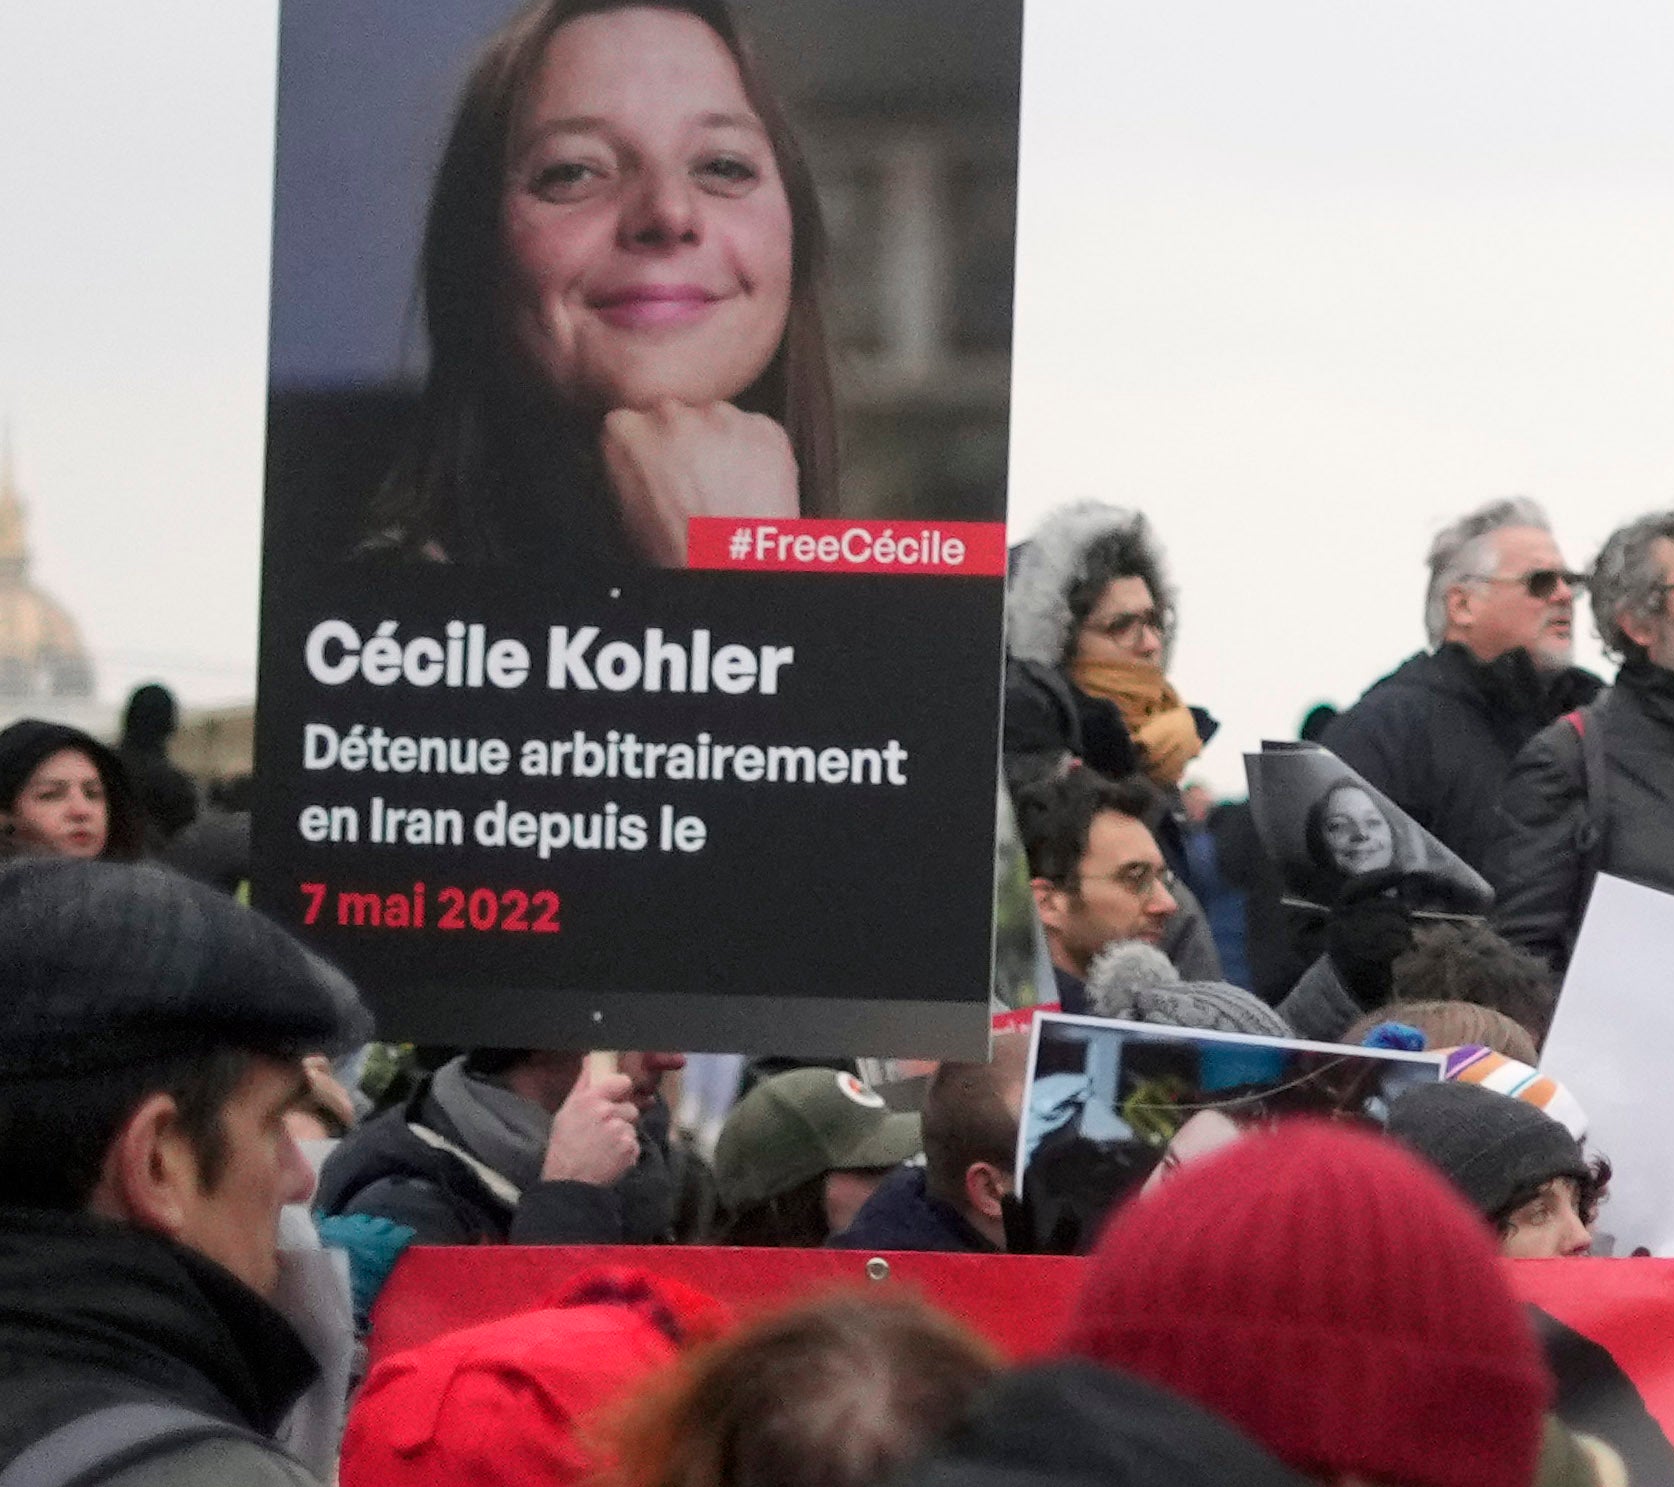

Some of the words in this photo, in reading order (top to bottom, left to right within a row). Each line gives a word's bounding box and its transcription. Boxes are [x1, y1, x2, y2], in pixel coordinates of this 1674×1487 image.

[729, 526, 966, 566] #FreeCécile
[305, 619, 528, 688] Cécile
[548, 627, 794, 695] Kohler
[304, 723, 509, 775] Détenue
[521, 731, 907, 786] arbitrairement
[299, 803, 357, 843] en
[371, 798, 463, 846] Iran
[475, 802, 647, 858] depuis
[661, 805, 706, 852] le
[301, 882, 325, 925] 7
[338, 882, 425, 928] mai
[437, 888, 560, 933] 2022
